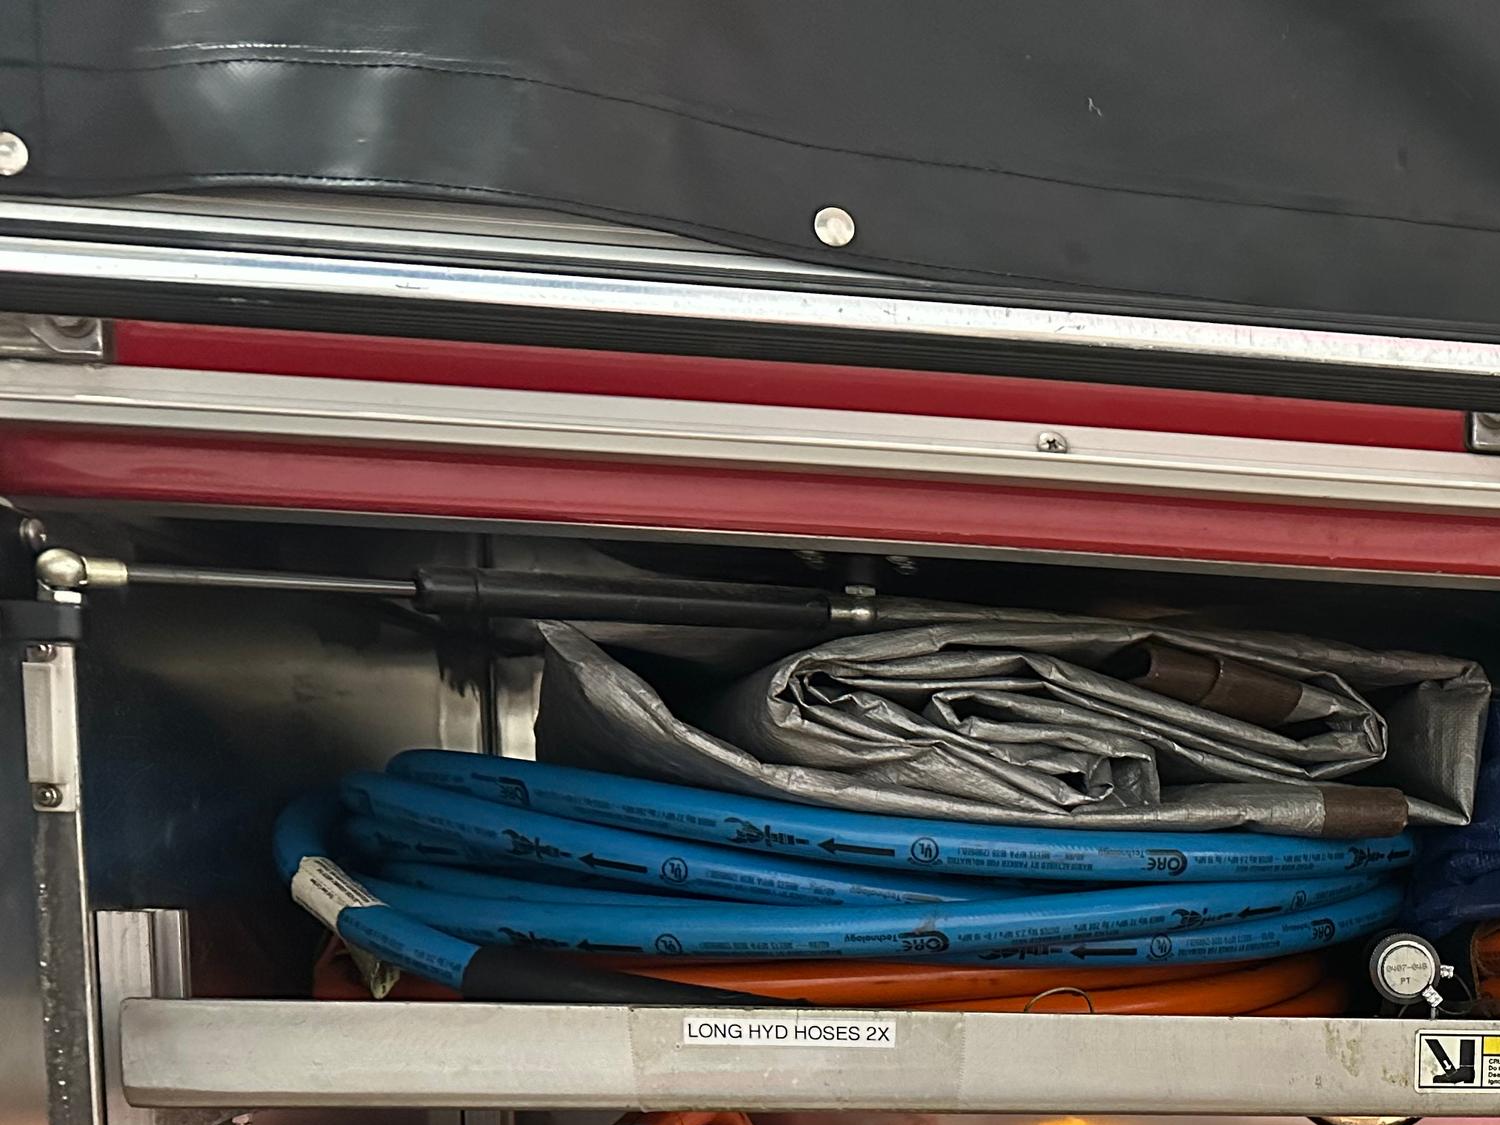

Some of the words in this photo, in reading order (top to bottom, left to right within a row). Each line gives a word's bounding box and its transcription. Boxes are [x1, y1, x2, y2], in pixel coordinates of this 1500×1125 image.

[1148, 849, 1188, 877] CORE
[844, 932, 898, 944] Technology
[900, 931, 949, 954] CORE
[688, 1024, 742, 1039] LONG
[749, 1025, 788, 1039] HYD
[795, 1026, 861, 1041] HOSES
[866, 1027, 890, 1042] 2X
